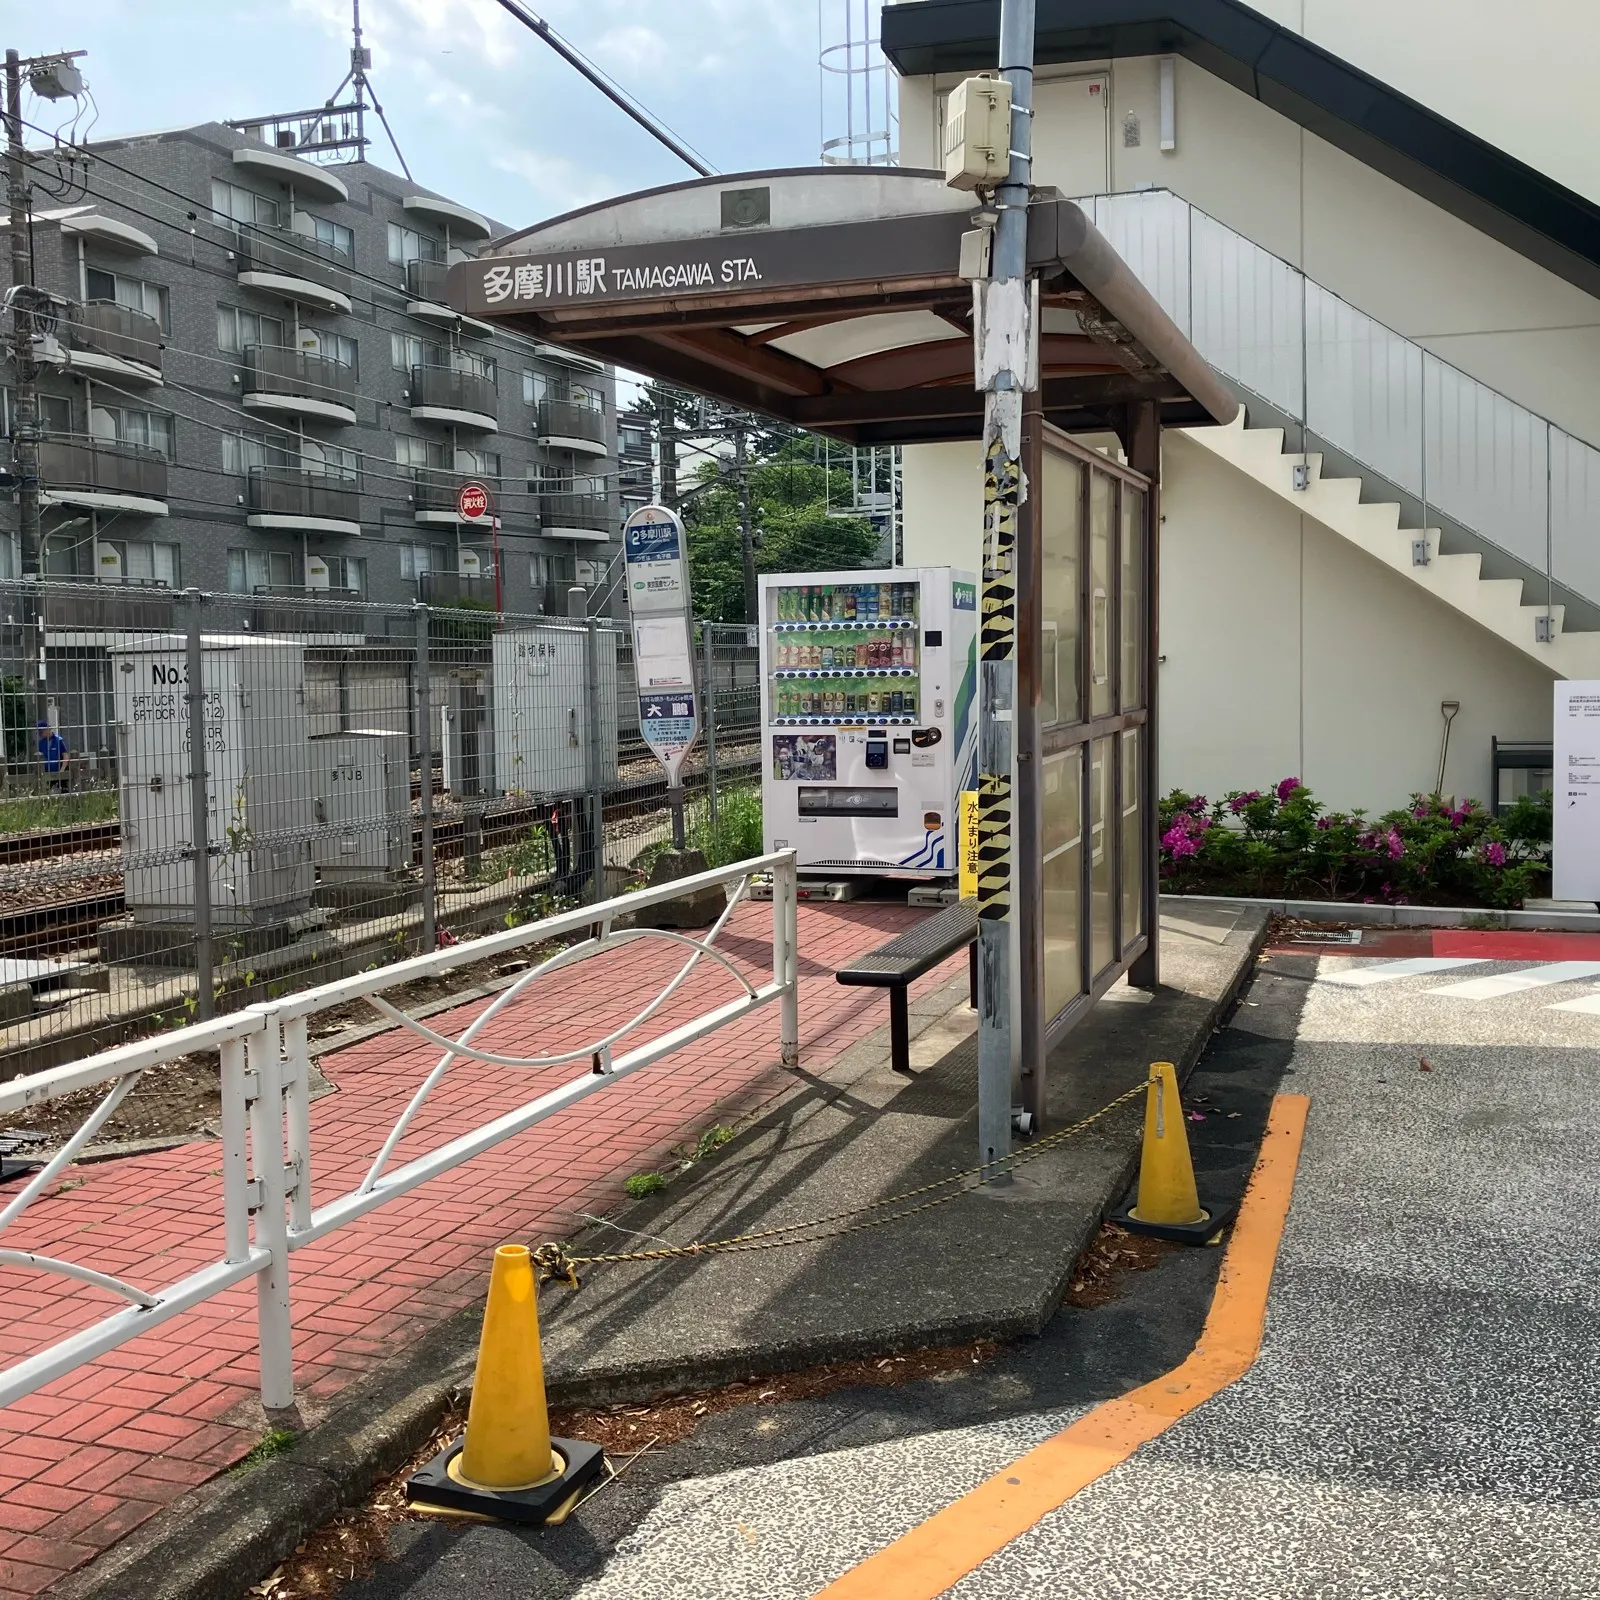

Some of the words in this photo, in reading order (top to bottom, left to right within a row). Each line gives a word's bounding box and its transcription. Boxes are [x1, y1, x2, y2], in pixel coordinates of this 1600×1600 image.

[483, 257, 607, 303] 多摩川駅
[612, 264, 714, 290] TAMAGAWA
[721, 257, 762, 283] STA.
[463, 495, 485, 509] 消火栓
[632, 530, 640, 545] 2
[640, 528, 672, 539] 多摩川駅
[967, 801, 979, 874] 水たまり注意
